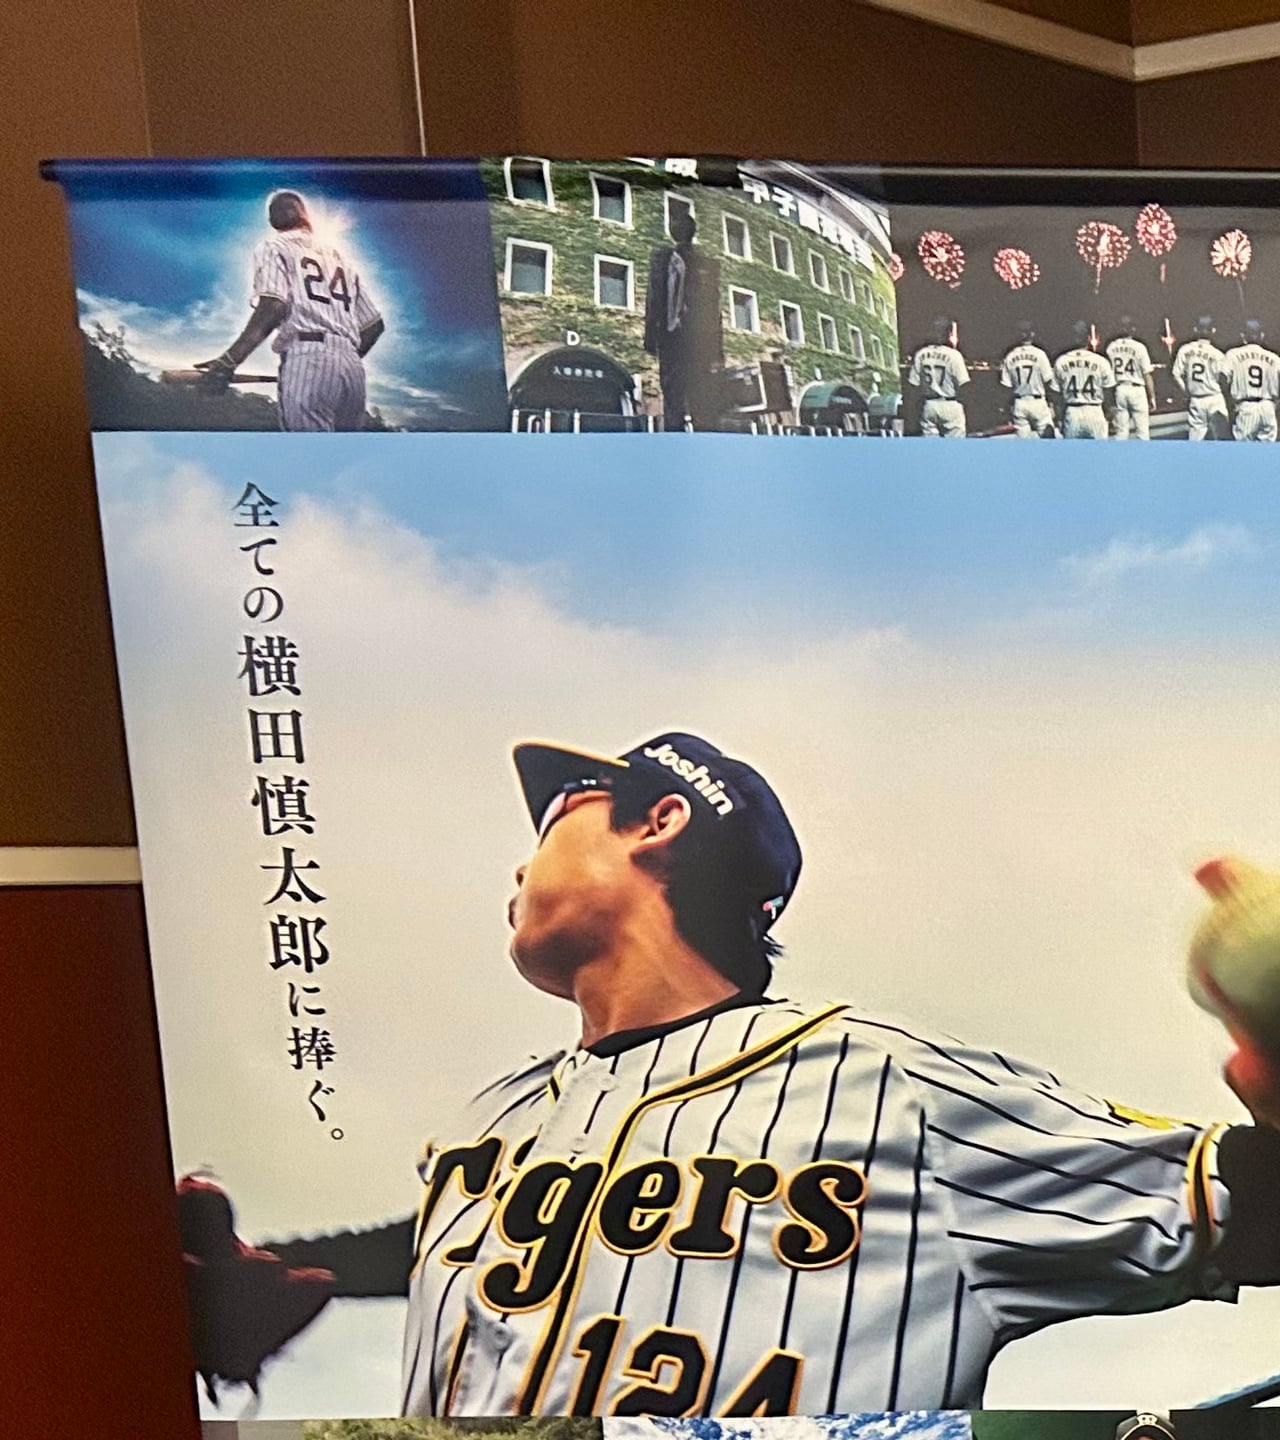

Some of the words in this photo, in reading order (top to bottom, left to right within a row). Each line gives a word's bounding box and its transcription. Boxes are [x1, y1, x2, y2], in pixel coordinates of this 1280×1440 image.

[300, 256, 353, 312] 24
[566, 330, 581, 347] D
[1014, 364, 1033, 387] 17
[1113, 356, 1136, 377] 24
[1191, 362, 1206, 382] 2
[1248, 365, 1264, 389] 9
[1066, 374, 1098, 398] 44
[643, 741, 735, 816] Joshin
[230, 482, 344, 1141] 全ての横田慎太郎に捧ぐ。
